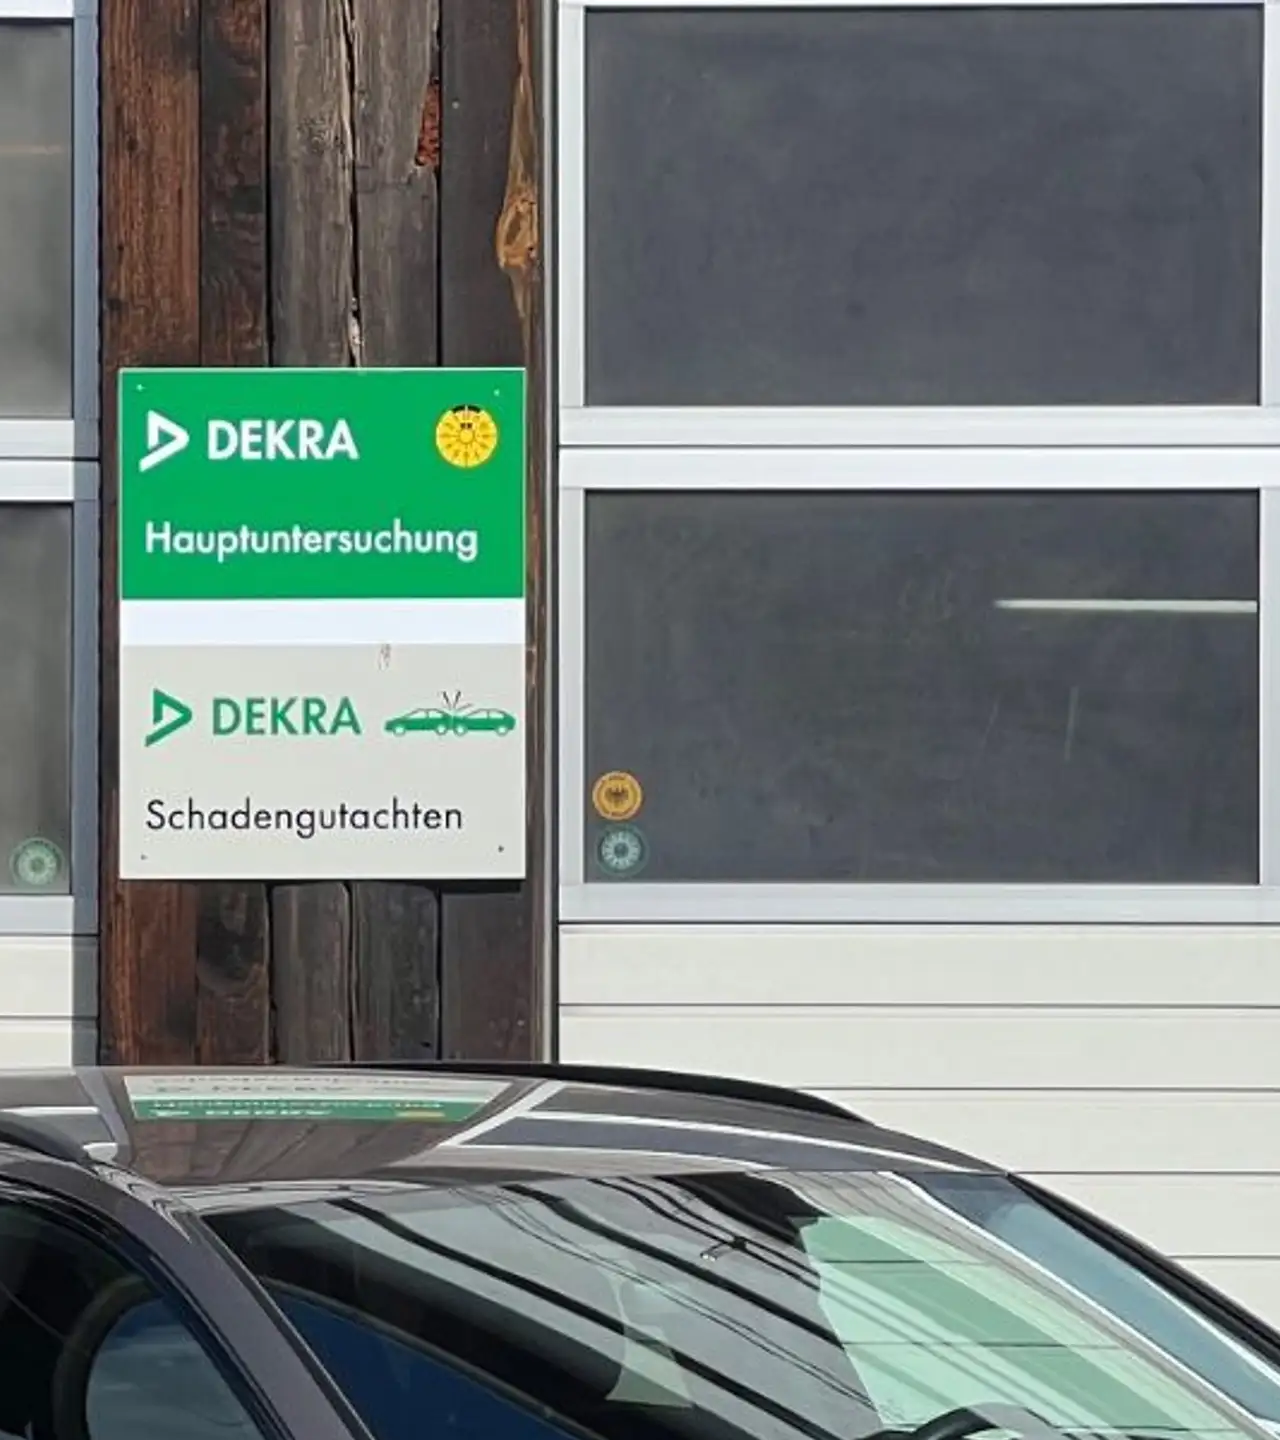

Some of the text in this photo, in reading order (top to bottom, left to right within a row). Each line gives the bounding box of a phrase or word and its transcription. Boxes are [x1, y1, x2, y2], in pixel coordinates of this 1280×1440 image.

[206, 419, 360, 461] DEKRA
[145, 518, 478, 563] Hauptuntersuchung
[211, 696, 362, 736] DEKRA
[145, 796, 463, 840] Schadengutachten
